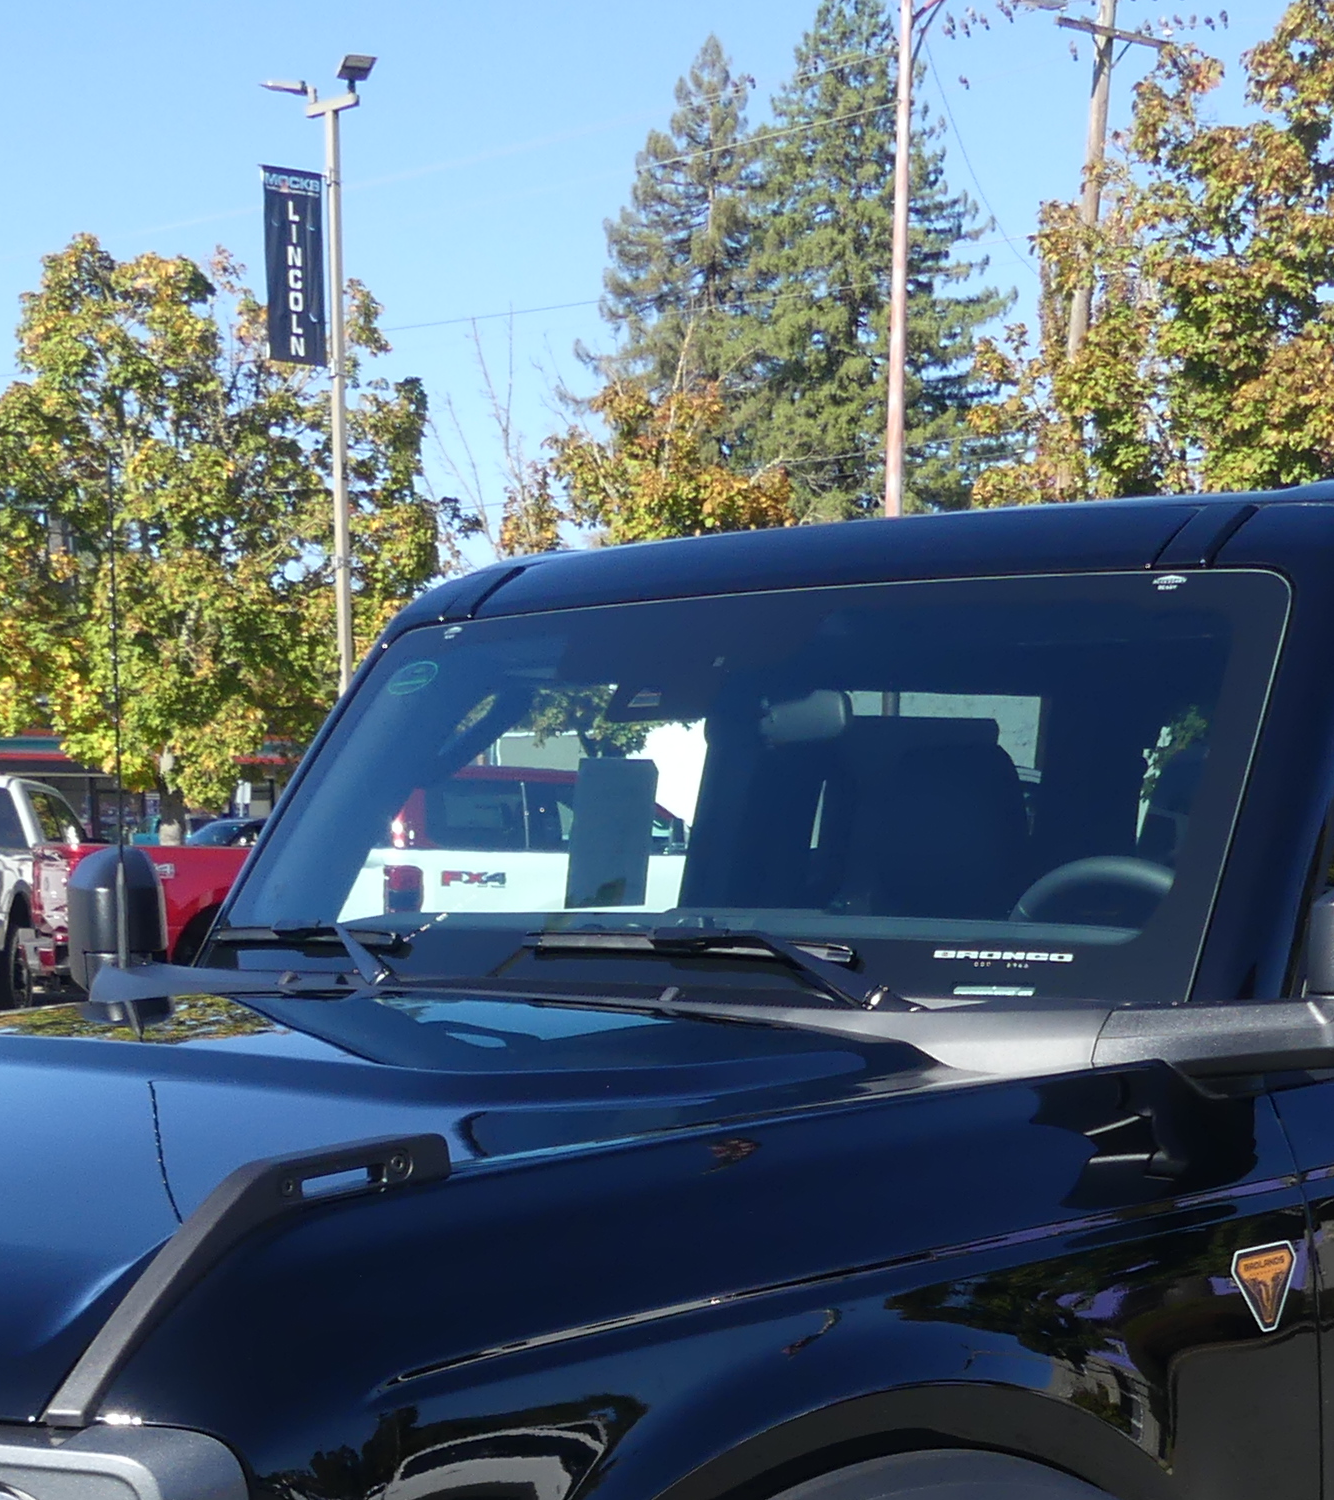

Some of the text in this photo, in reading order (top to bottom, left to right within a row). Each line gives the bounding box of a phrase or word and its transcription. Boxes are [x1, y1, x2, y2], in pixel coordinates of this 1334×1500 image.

[264, 172, 320, 192] MOCKS
[286, 200, 306, 358] LINCOLN
[441, 870, 507, 887] FX4
[933, 950, 1074, 963] BRONCO
